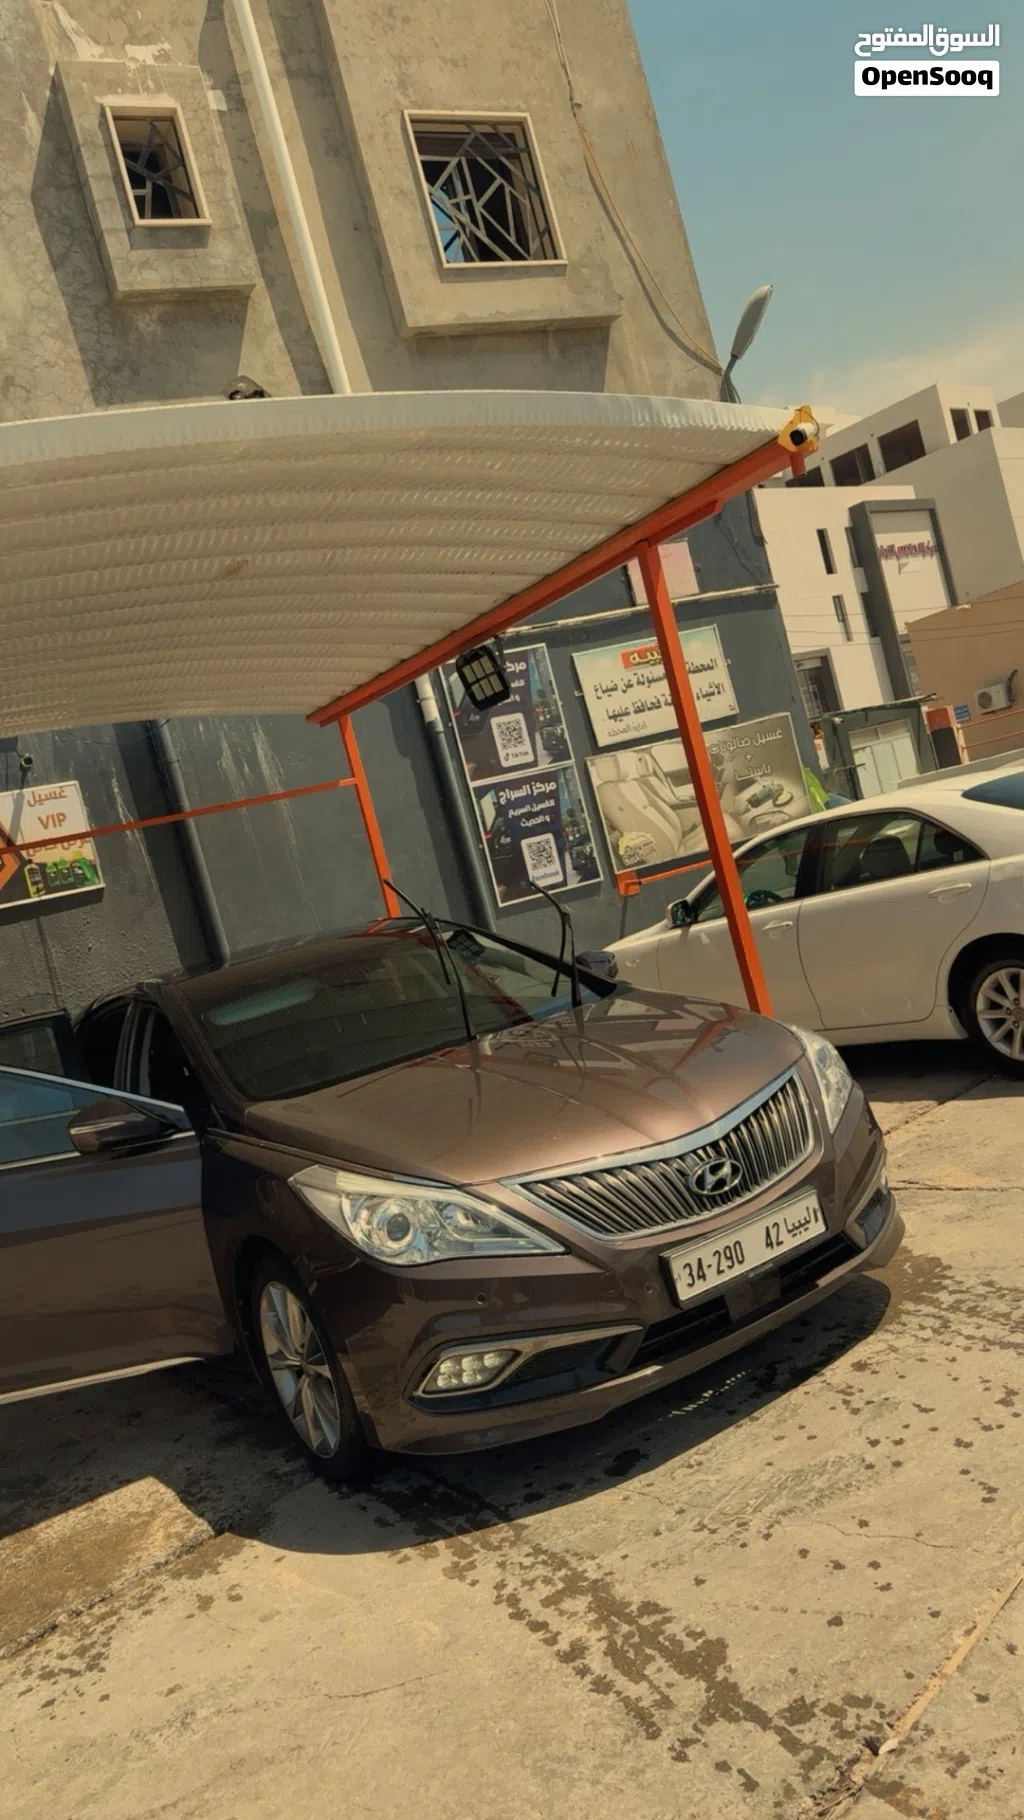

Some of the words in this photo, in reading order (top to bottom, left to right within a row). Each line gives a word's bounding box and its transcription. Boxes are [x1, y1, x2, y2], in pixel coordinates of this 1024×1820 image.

[686, 658, 718, 674] المحطة
[593, 680, 619, 699] ضياع
[621, 677, 634, 694] عن
[607, 704, 631, 723] عليها
[633, 696, 662, 715] فحافظ
[607, 725, 633, 738] المحطة
[754, 728, 784, 746] غسيل
[707, 736, 752, 755] صالونات
[27, 787, 68, 808] غسيل
[499, 785, 532, 805] السراج
[532, 781, 557, 796] مركز
[37, 812, 67, 830] VIP
[508, 805, 531, 819] السريع
[531, 869, 560, 882] facebook
[683, 1239, 745, 1288] 34-290
[765, 1222, 784, 1251] 42
